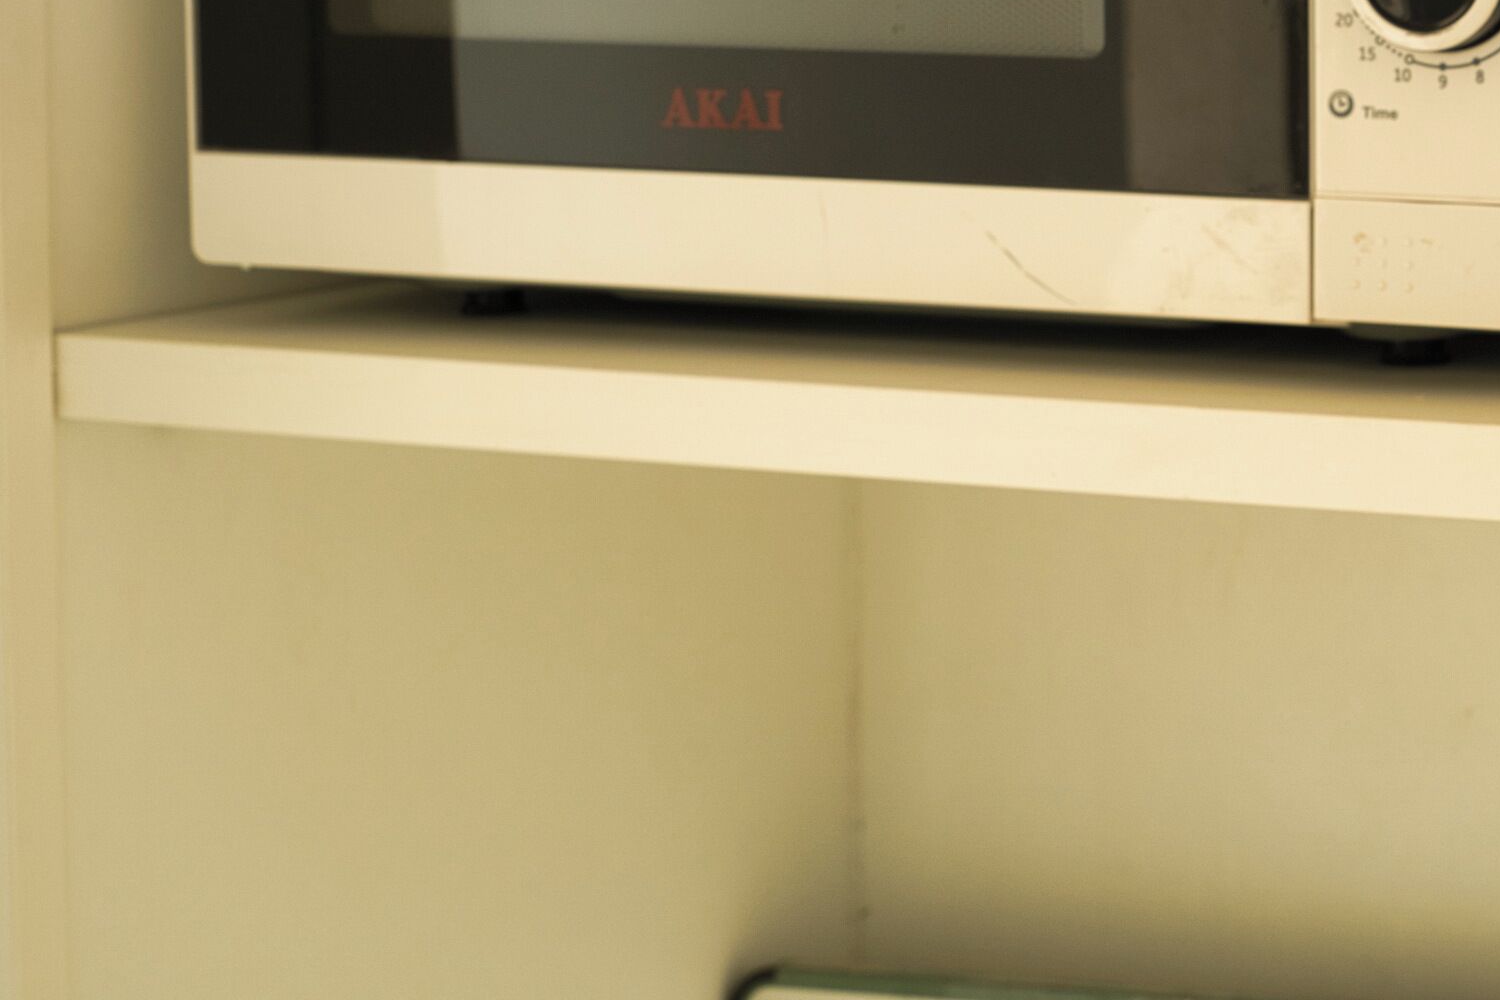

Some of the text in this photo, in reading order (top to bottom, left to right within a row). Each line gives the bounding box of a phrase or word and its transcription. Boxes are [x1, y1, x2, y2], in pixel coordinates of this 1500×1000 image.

[1335, 13, 1353, 27] 20
[1359, 47, 1376, 61] 15
[1394, 68, 1412, 83] 10
[1438, 75, 1447, 89] 9
[1475, 70, 1485, 84] 8
[660, 86, 785, 132] AKAI
[1363, 105, 1398, 120] Time
